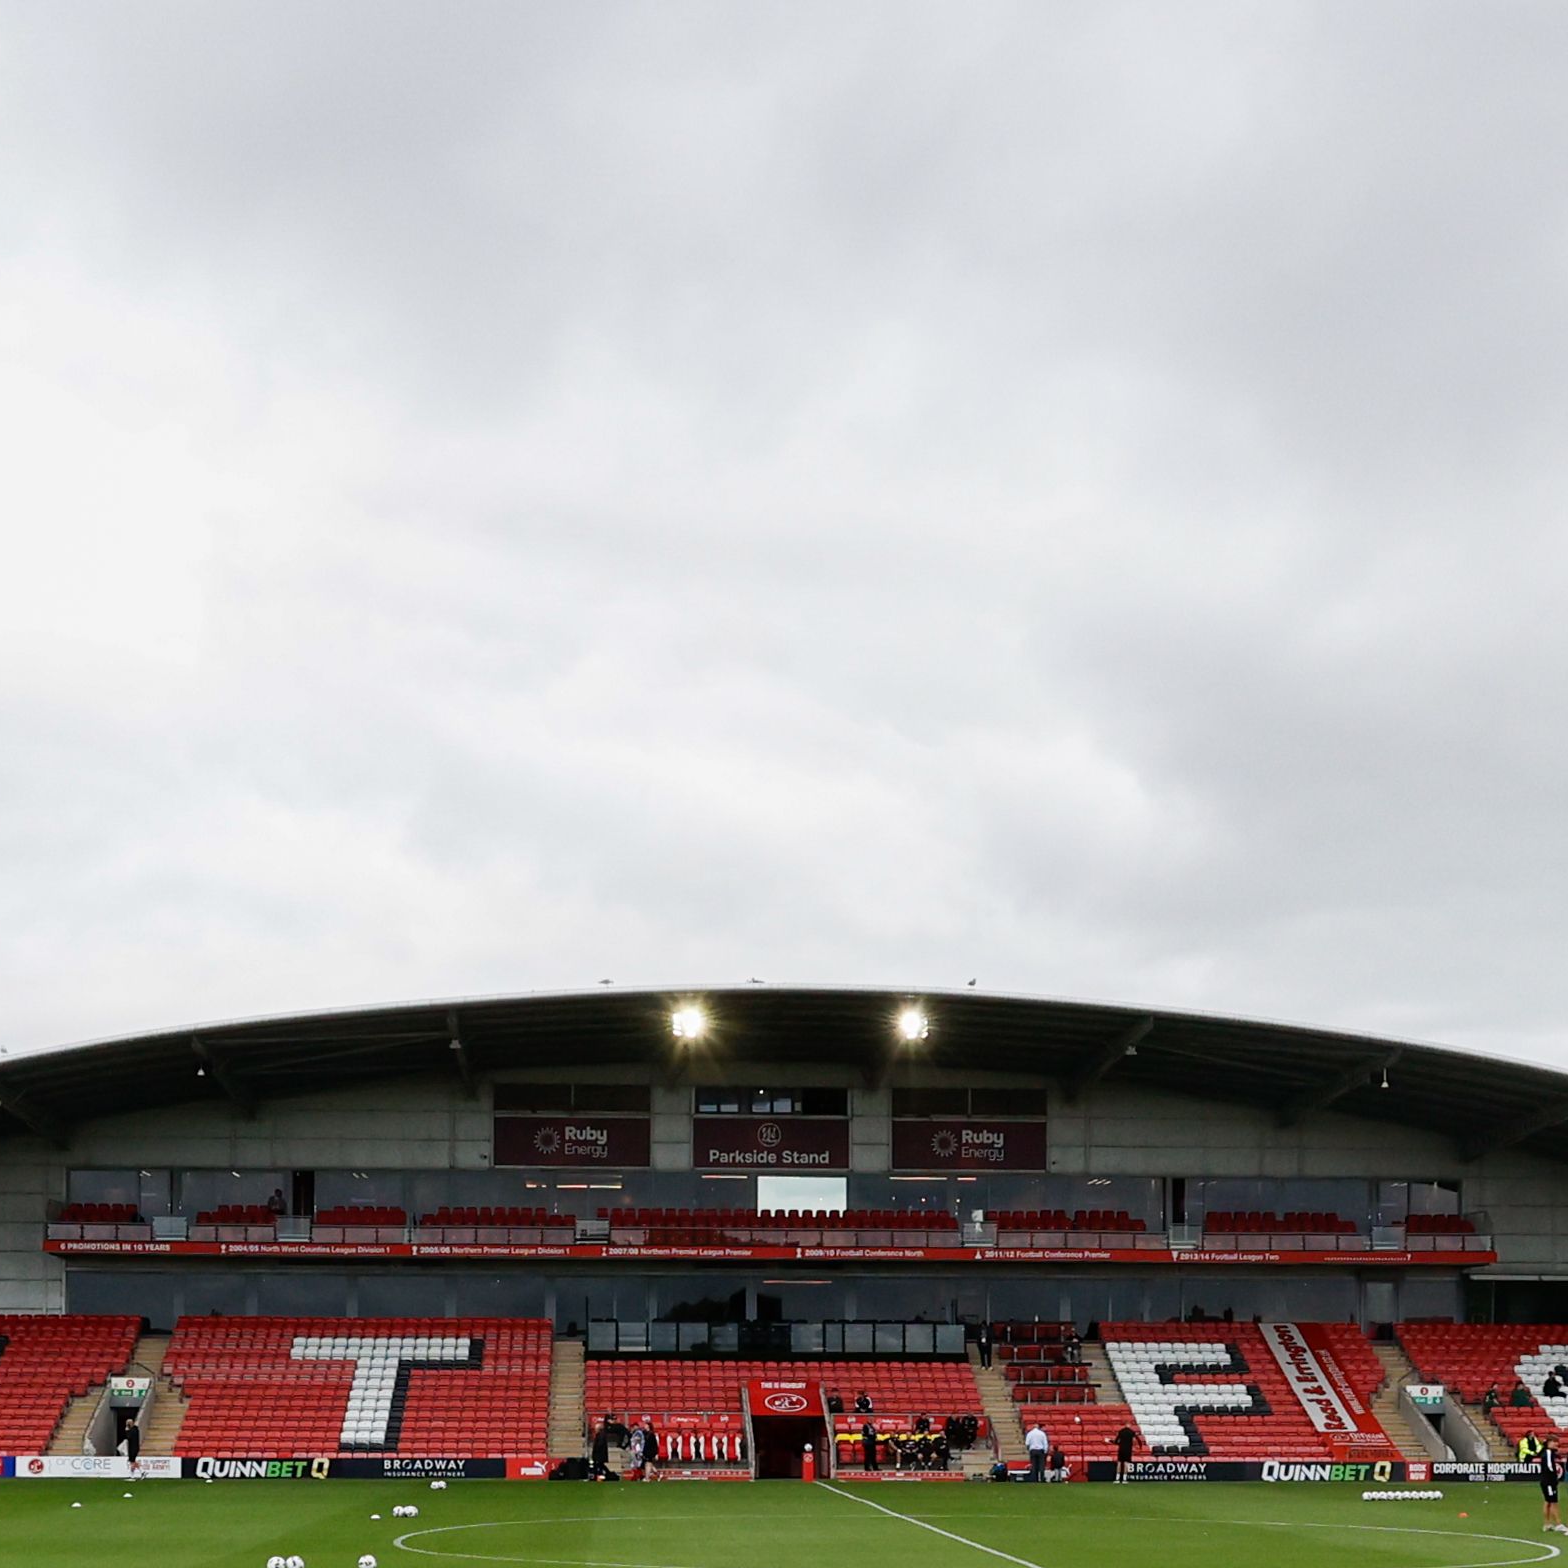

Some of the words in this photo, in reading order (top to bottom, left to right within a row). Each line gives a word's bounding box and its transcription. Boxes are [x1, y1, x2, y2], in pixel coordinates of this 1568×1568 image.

[564, 1126, 608, 1145] Ruby
[961, 1130, 1004, 1147] Ruby
[564, 1143, 608, 1158] Energy
[708, 1149, 777, 1164] Parkside
[782, 1150, 830, 1164] Stand
[961, 1147, 1004, 1161] Energy
[67, 1243, 121, 1251] PROMOTIONS
[122, 1243, 131, 1251] IN
[145, 1243, 171, 1251] YEARS
[261, 1245, 280, 1253] North
[282, 1245, 299, 1253] West
[300, 1245, 330, 1253] Counties
[331, 1246, 356, 1255] League
[452, 1246, 482, 1254] Northern
[483, 1247, 511, 1255] Premier
[511, 1247, 536, 1256] League
[537, 1247, 565, 1255] Division
[671, 1248, 698, 1256] Premier
[699, 1248, 724, 1257] League
[1211, 1253, 1238, 1261] Football
[1239, 1253, 1264, 1262] League
[1265, 1252, 1280, 1260] Two
[1273, 1324, 1319, 1383] Errington
[290, 1337, 478, 1448] T
[1106, 1342, 1263, 1450] F
[1303, 1386, 1326, 1396] &
[1307, 1398, 1349, 1431] Read
[195, 1457, 307, 1478] QUINNBET
[311, 1457, 330, 1479] Q
[383, 1459, 466, 1470] BROADWAY
[1126, 1462, 1208, 1473] BROADWAY
[1261, 1460, 1369, 1482] QUINNBET
[1373, 1460, 1392, 1482] Q
[1408, 1463, 1427, 1472] BOOK
[1433, 1463, 1485, 1474] CORPORATE
[1487, 1463, 1542, 1474] HOSPITALITY
